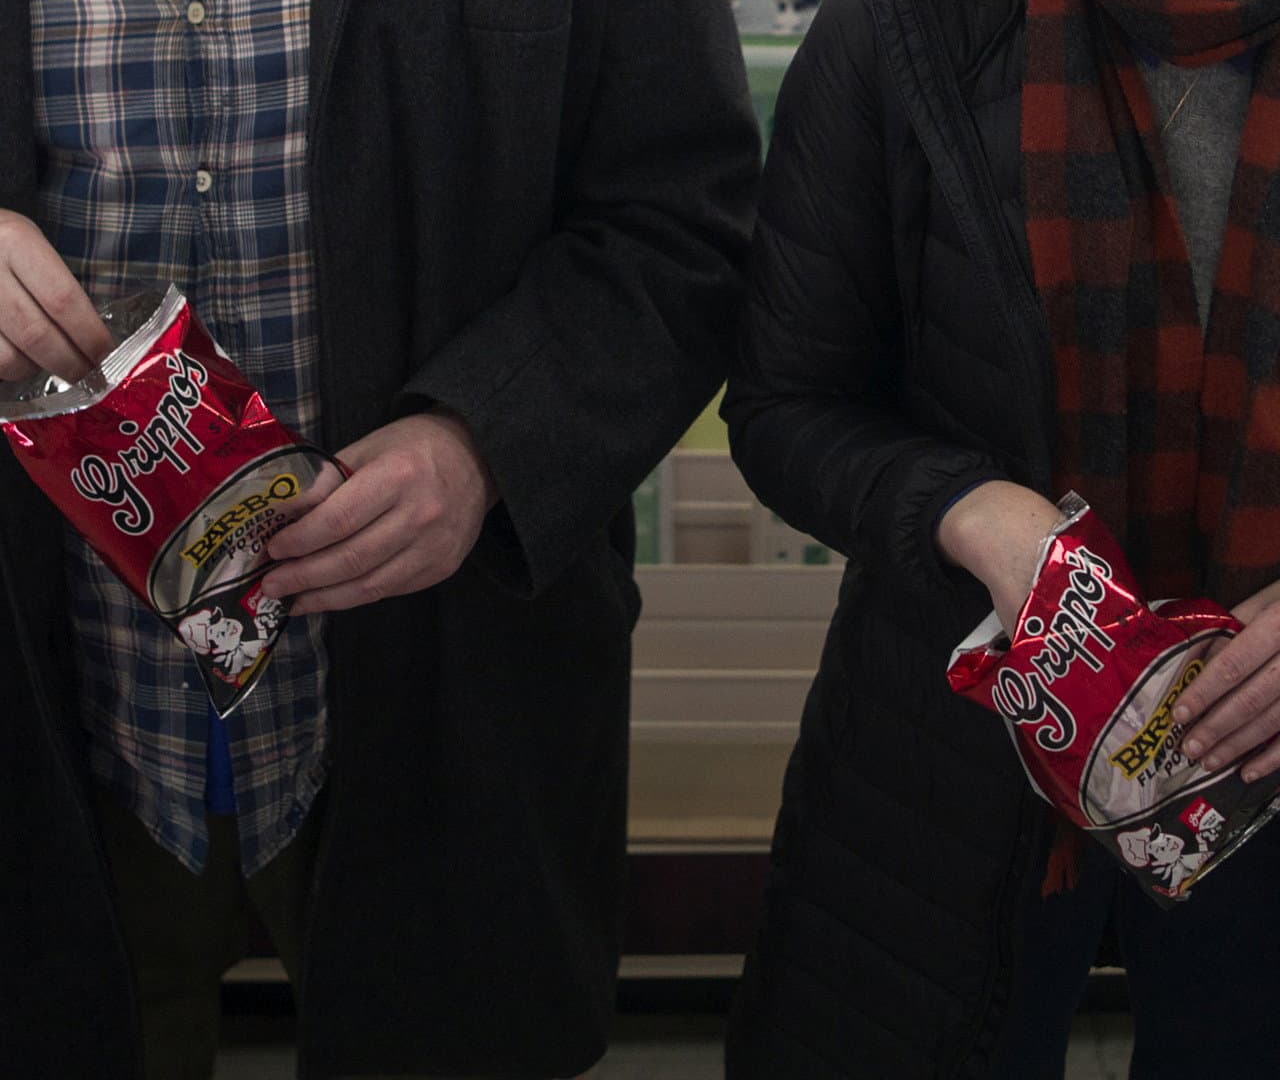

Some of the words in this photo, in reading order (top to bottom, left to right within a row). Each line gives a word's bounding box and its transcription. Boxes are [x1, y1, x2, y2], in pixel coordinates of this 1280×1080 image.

[70, 348, 208, 536] Grippo's
[180, 473, 299, 568] BAR-B-Q
[227, 512, 286, 560] POTATO
[992, 545, 1115, 751] Grippo's
